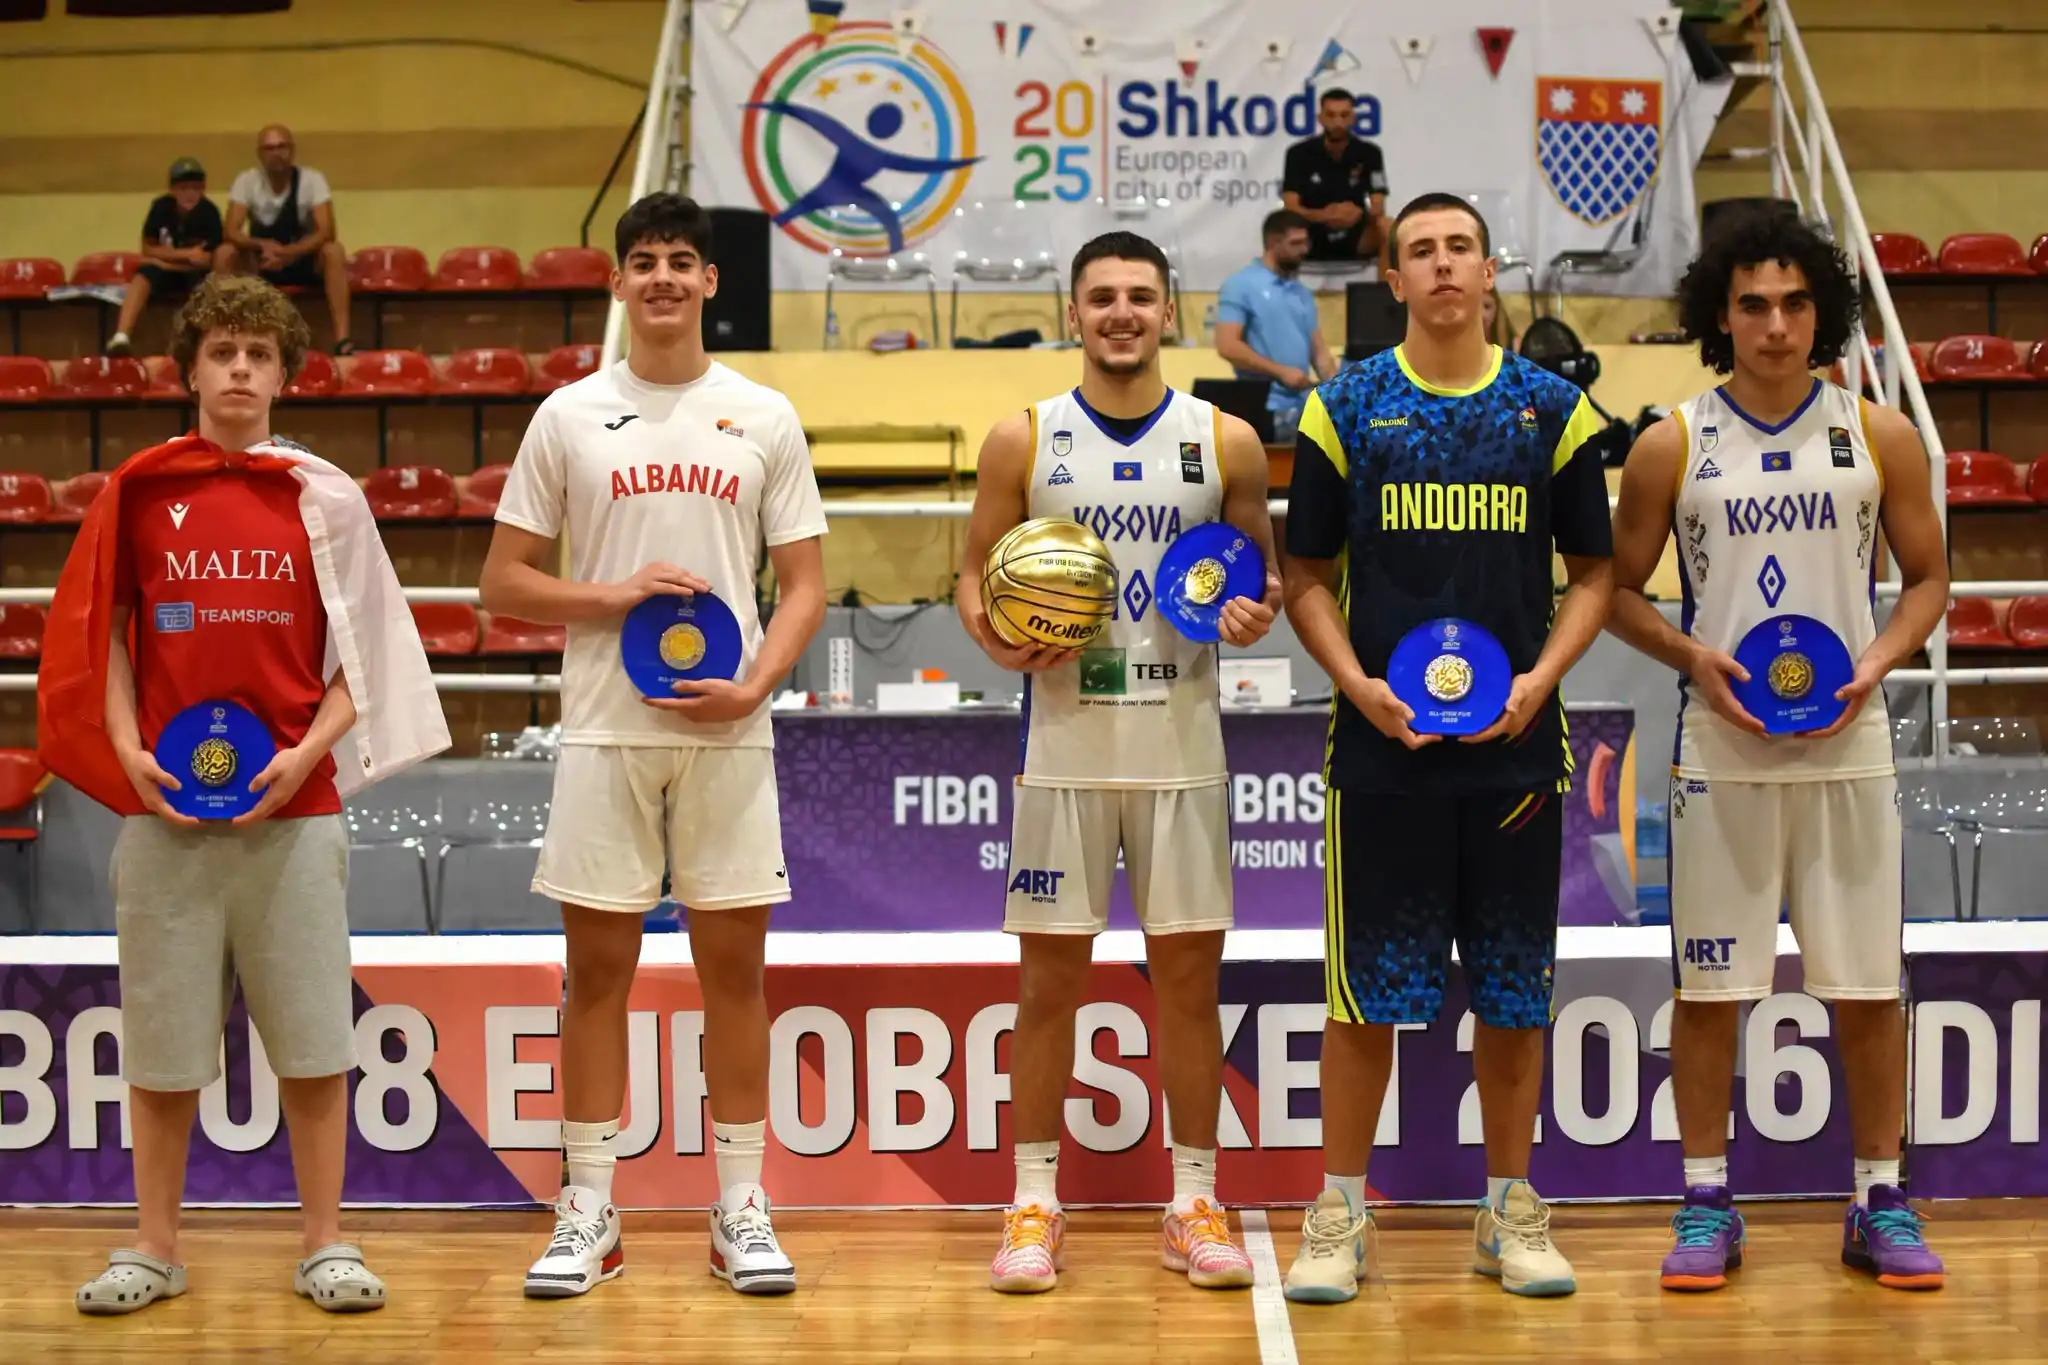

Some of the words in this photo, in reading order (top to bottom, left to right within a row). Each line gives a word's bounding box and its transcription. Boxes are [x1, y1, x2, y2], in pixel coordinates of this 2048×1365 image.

[1014, 80, 1094, 139] 20
[1117, 80, 1382, 139] Shkoda
[1014, 144, 1092, 203] 25
[1115, 145, 1247, 176] European
[1114, 177, 1160, 205] city
[1179, 176, 1204, 200] of
[1965, 339, 1984, 360] 24
[1369, 416, 1408, 429] SPALDING
[1834, 449, 1850, 459] FIBA
[1962, 455, 1972, 476] 2
[1047, 475, 1075, 487] PEAK
[1184, 464, 1201, 474] FIBA
[1695, 469, 1722, 481] PEAK
[611, 463, 740, 506] ALBANIA
[1380, 482, 1528, 534] ANDORRA
[1724, 491, 1838, 536] KOSOVA
[164, 549, 297, 583] MALTA
[1027, 614, 1102, 640] molten
[1131, 663, 1178, 680] TEB
[1121, 699, 1139, 707] JOINT
[894, 774, 998, 825] FIBA
[1686, 785, 1708, 794] PEAK
[1008, 868, 1065, 896] ART
[1031, 896, 1057, 904] MOTION
[1683, 937, 1738, 964] ART
[1697, 964, 1731, 972] MOTION
